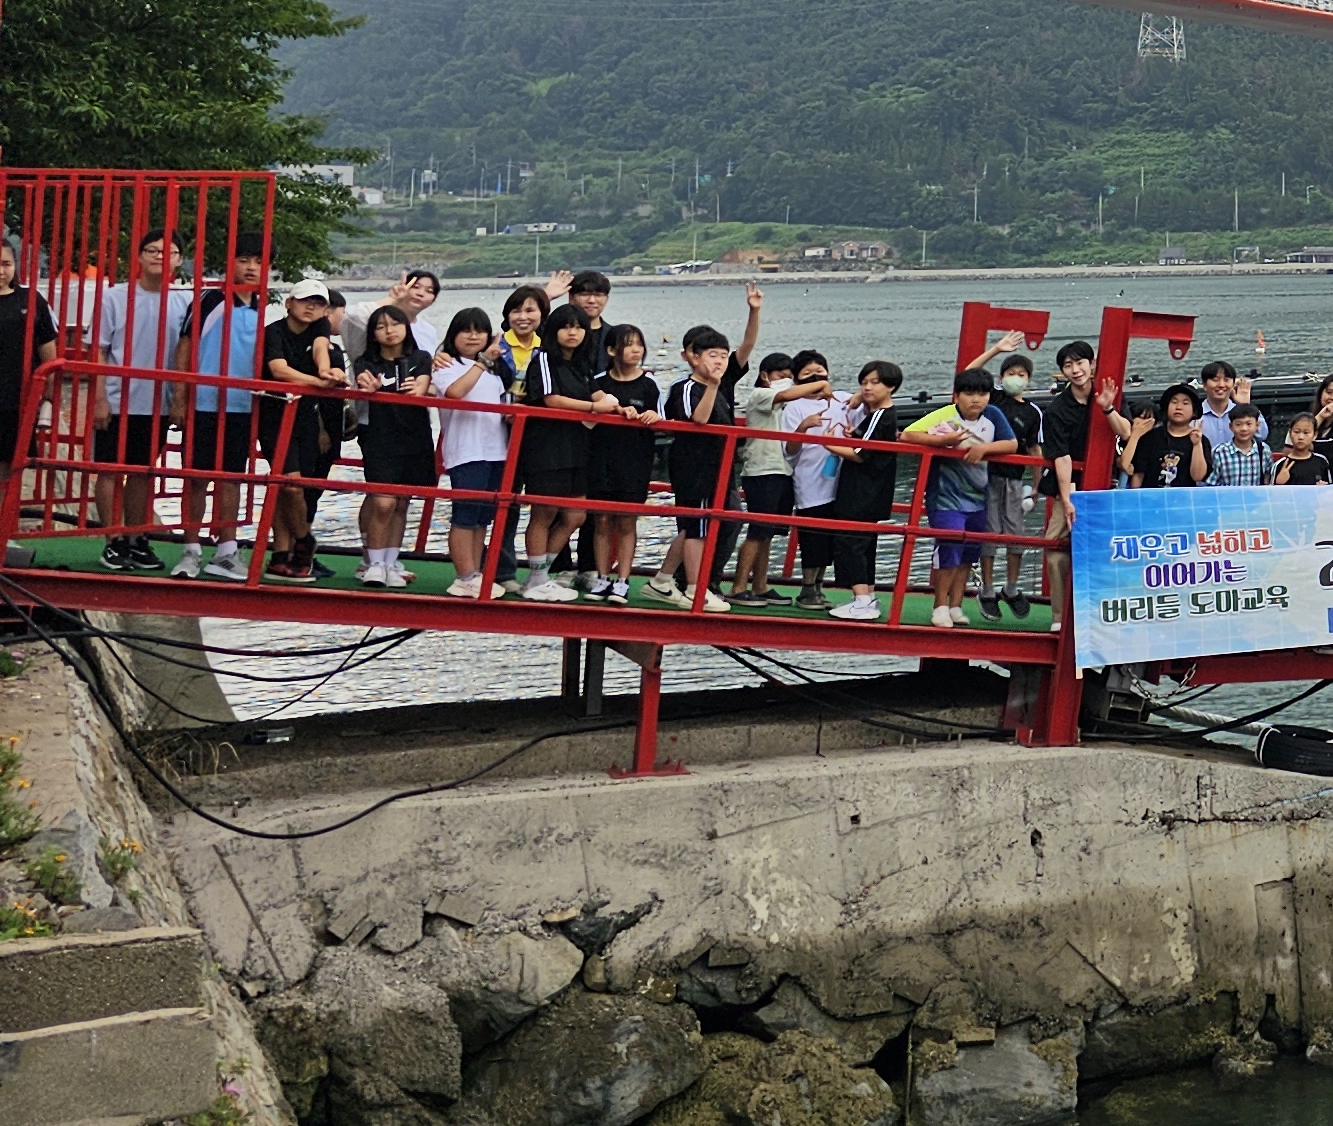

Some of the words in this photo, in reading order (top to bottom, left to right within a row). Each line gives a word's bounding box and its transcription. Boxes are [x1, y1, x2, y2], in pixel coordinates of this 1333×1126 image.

[1112, 532, 1190, 561] 채우고
[1197, 528, 1273, 556] 넓히고
[1145, 559, 1248, 588] 이어가는
[1102, 593, 1182, 623] 버리들
[1189, 585, 1290, 615] 도마교육
